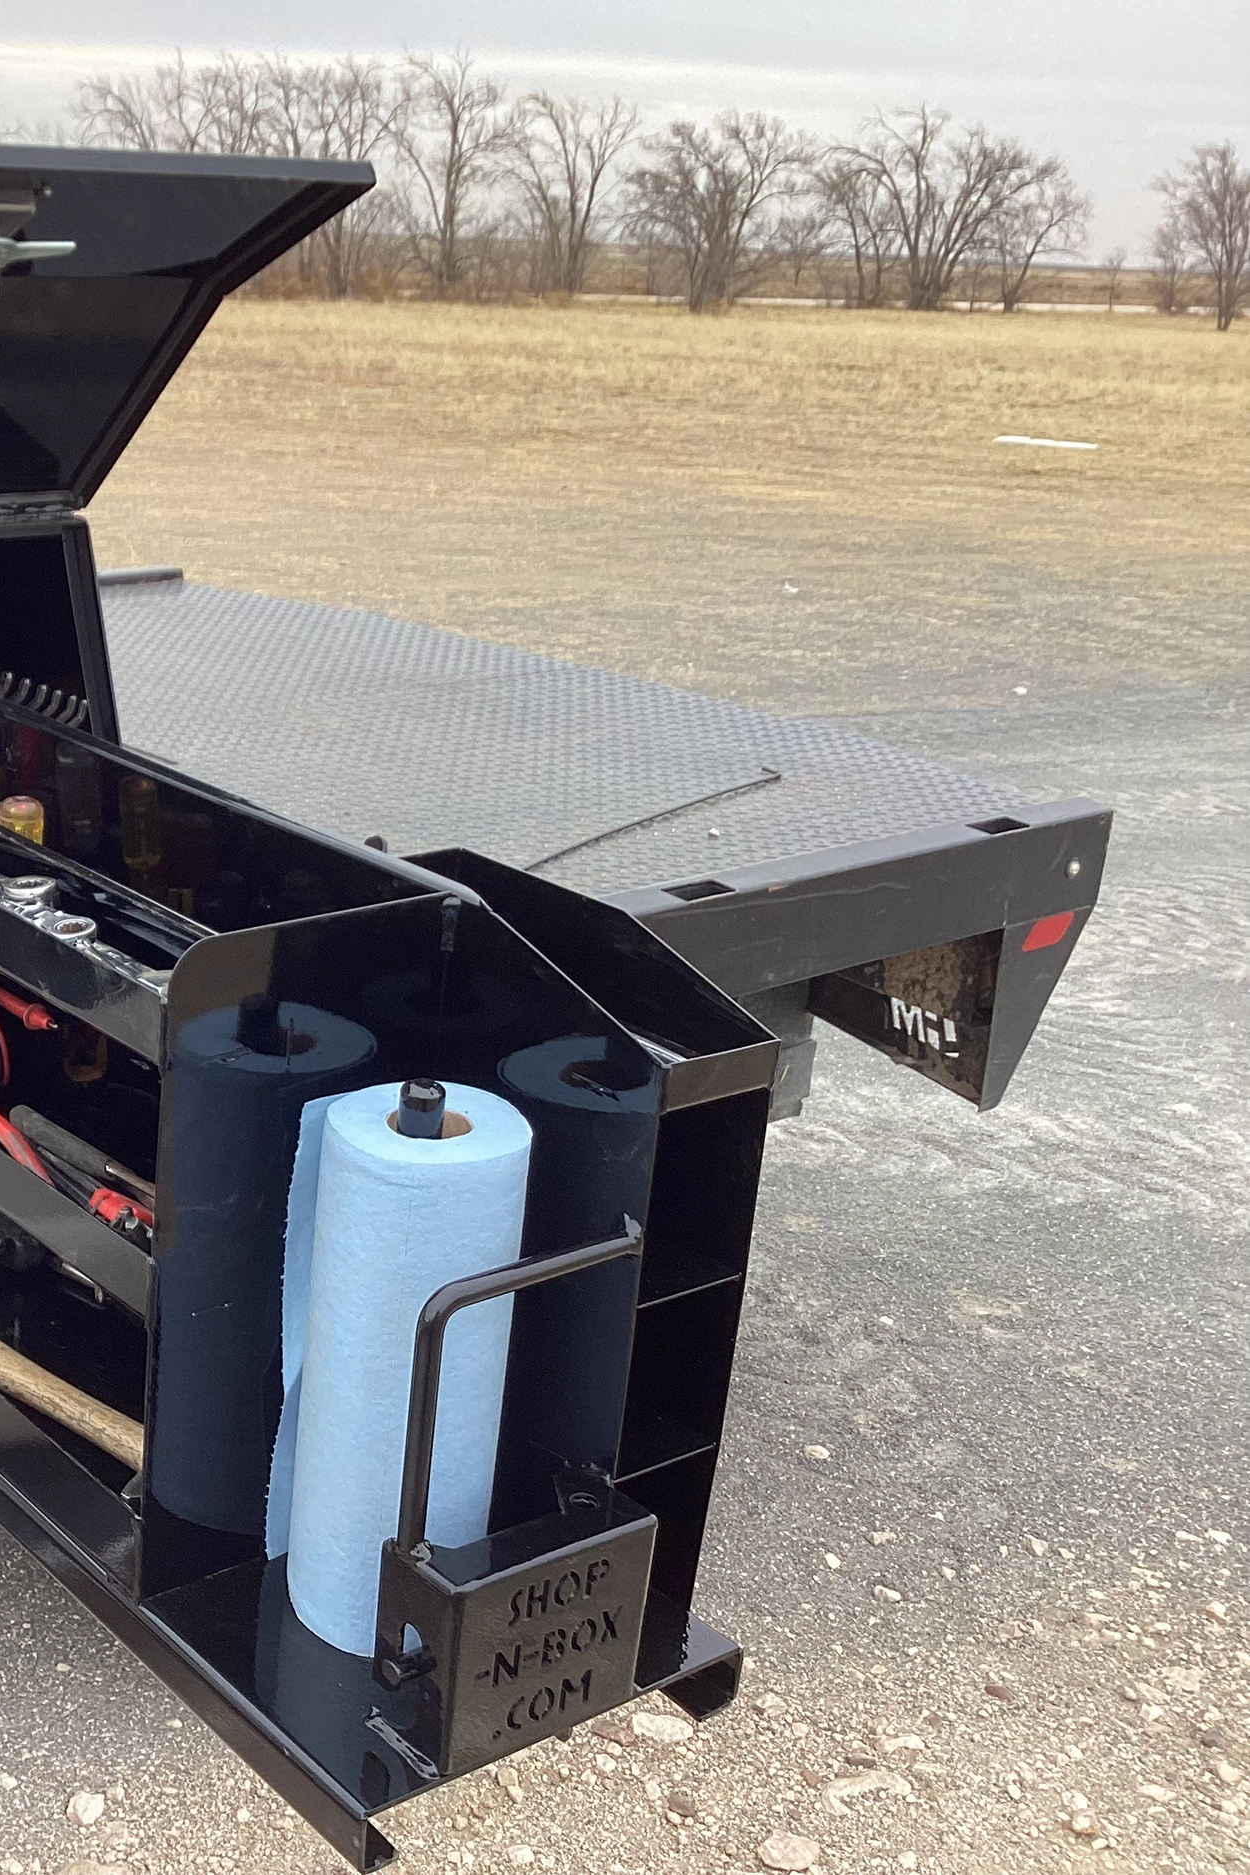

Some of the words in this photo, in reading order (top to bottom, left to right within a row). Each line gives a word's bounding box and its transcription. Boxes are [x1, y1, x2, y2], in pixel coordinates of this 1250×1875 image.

[508, 1558, 610, 1627] SHOP
[475, 1605, 622, 1688] -N-BOX
[492, 1669, 592, 1740] .COM
